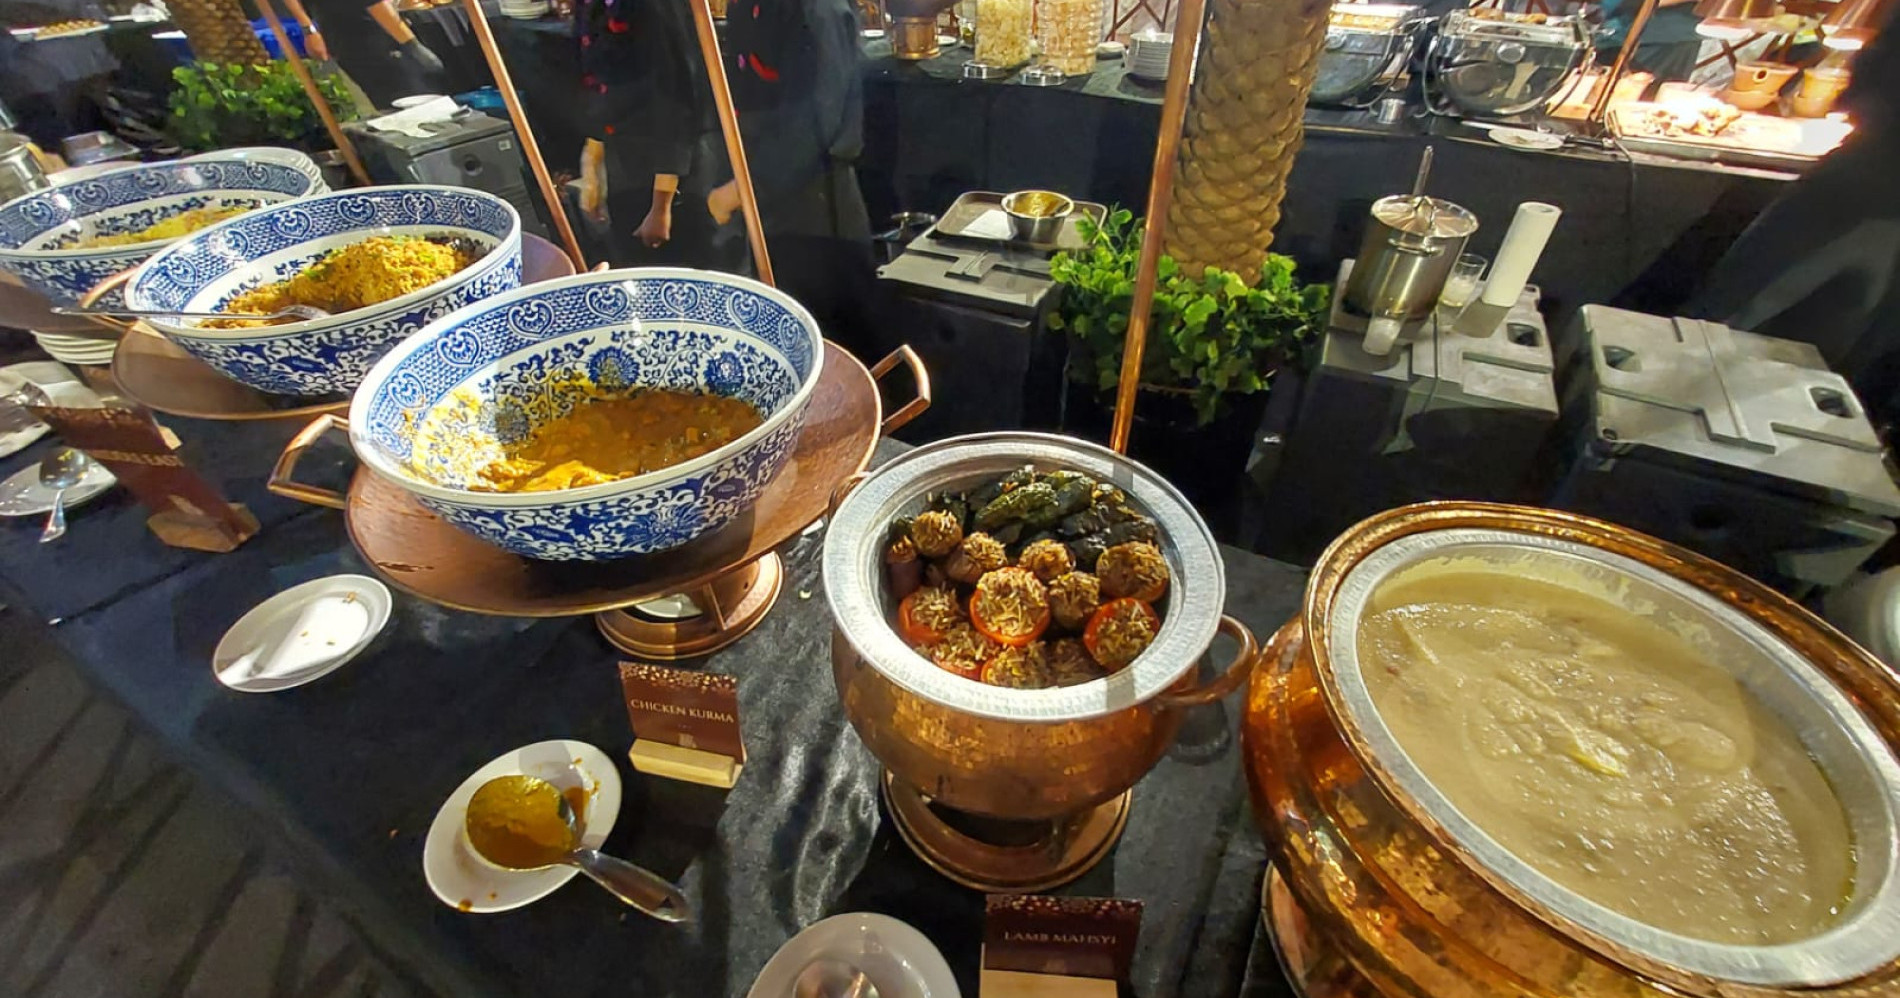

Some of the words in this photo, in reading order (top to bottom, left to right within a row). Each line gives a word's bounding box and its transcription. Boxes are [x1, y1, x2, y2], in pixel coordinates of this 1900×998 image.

[630, 698, 686, 716] CHICKEN
[688, 708, 735, 724] KURMA
[1004, 931, 1048, 942] LAMB
[1052, 934, 1117, 945] MAHSYI
